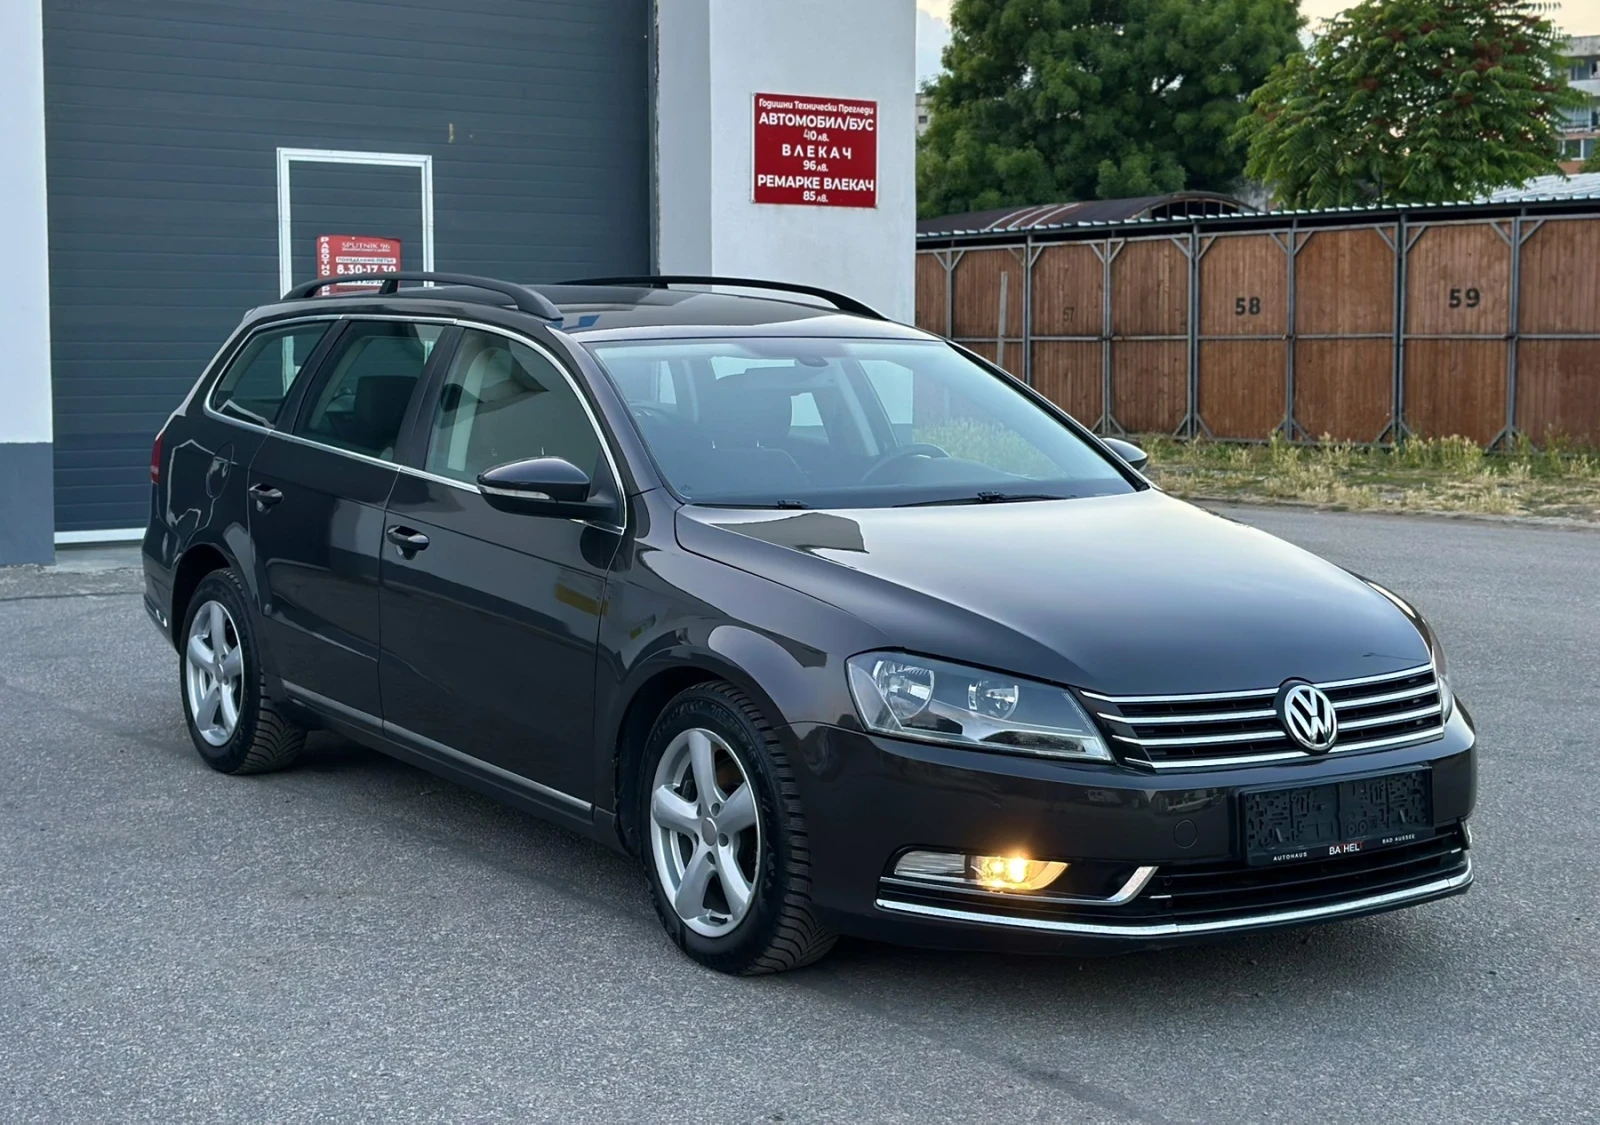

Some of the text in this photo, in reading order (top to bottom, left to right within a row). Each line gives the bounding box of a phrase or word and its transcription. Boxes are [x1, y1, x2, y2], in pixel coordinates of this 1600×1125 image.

[759, 98, 874, 116] Годишни Технически Прегледи
[758, 112, 875, 131] АВТОМОБИЛ/БУС
[781, 143, 852, 160] ВЛЕКАЧ
[757, 174, 875, 192] РЕМАРКЕ ВЛЕКАЧ
[1235, 296, 1261, 316] 58
[1448, 287, 1481, 309] 59
[1272, 851, 1308, 862] AUTOHAUS
